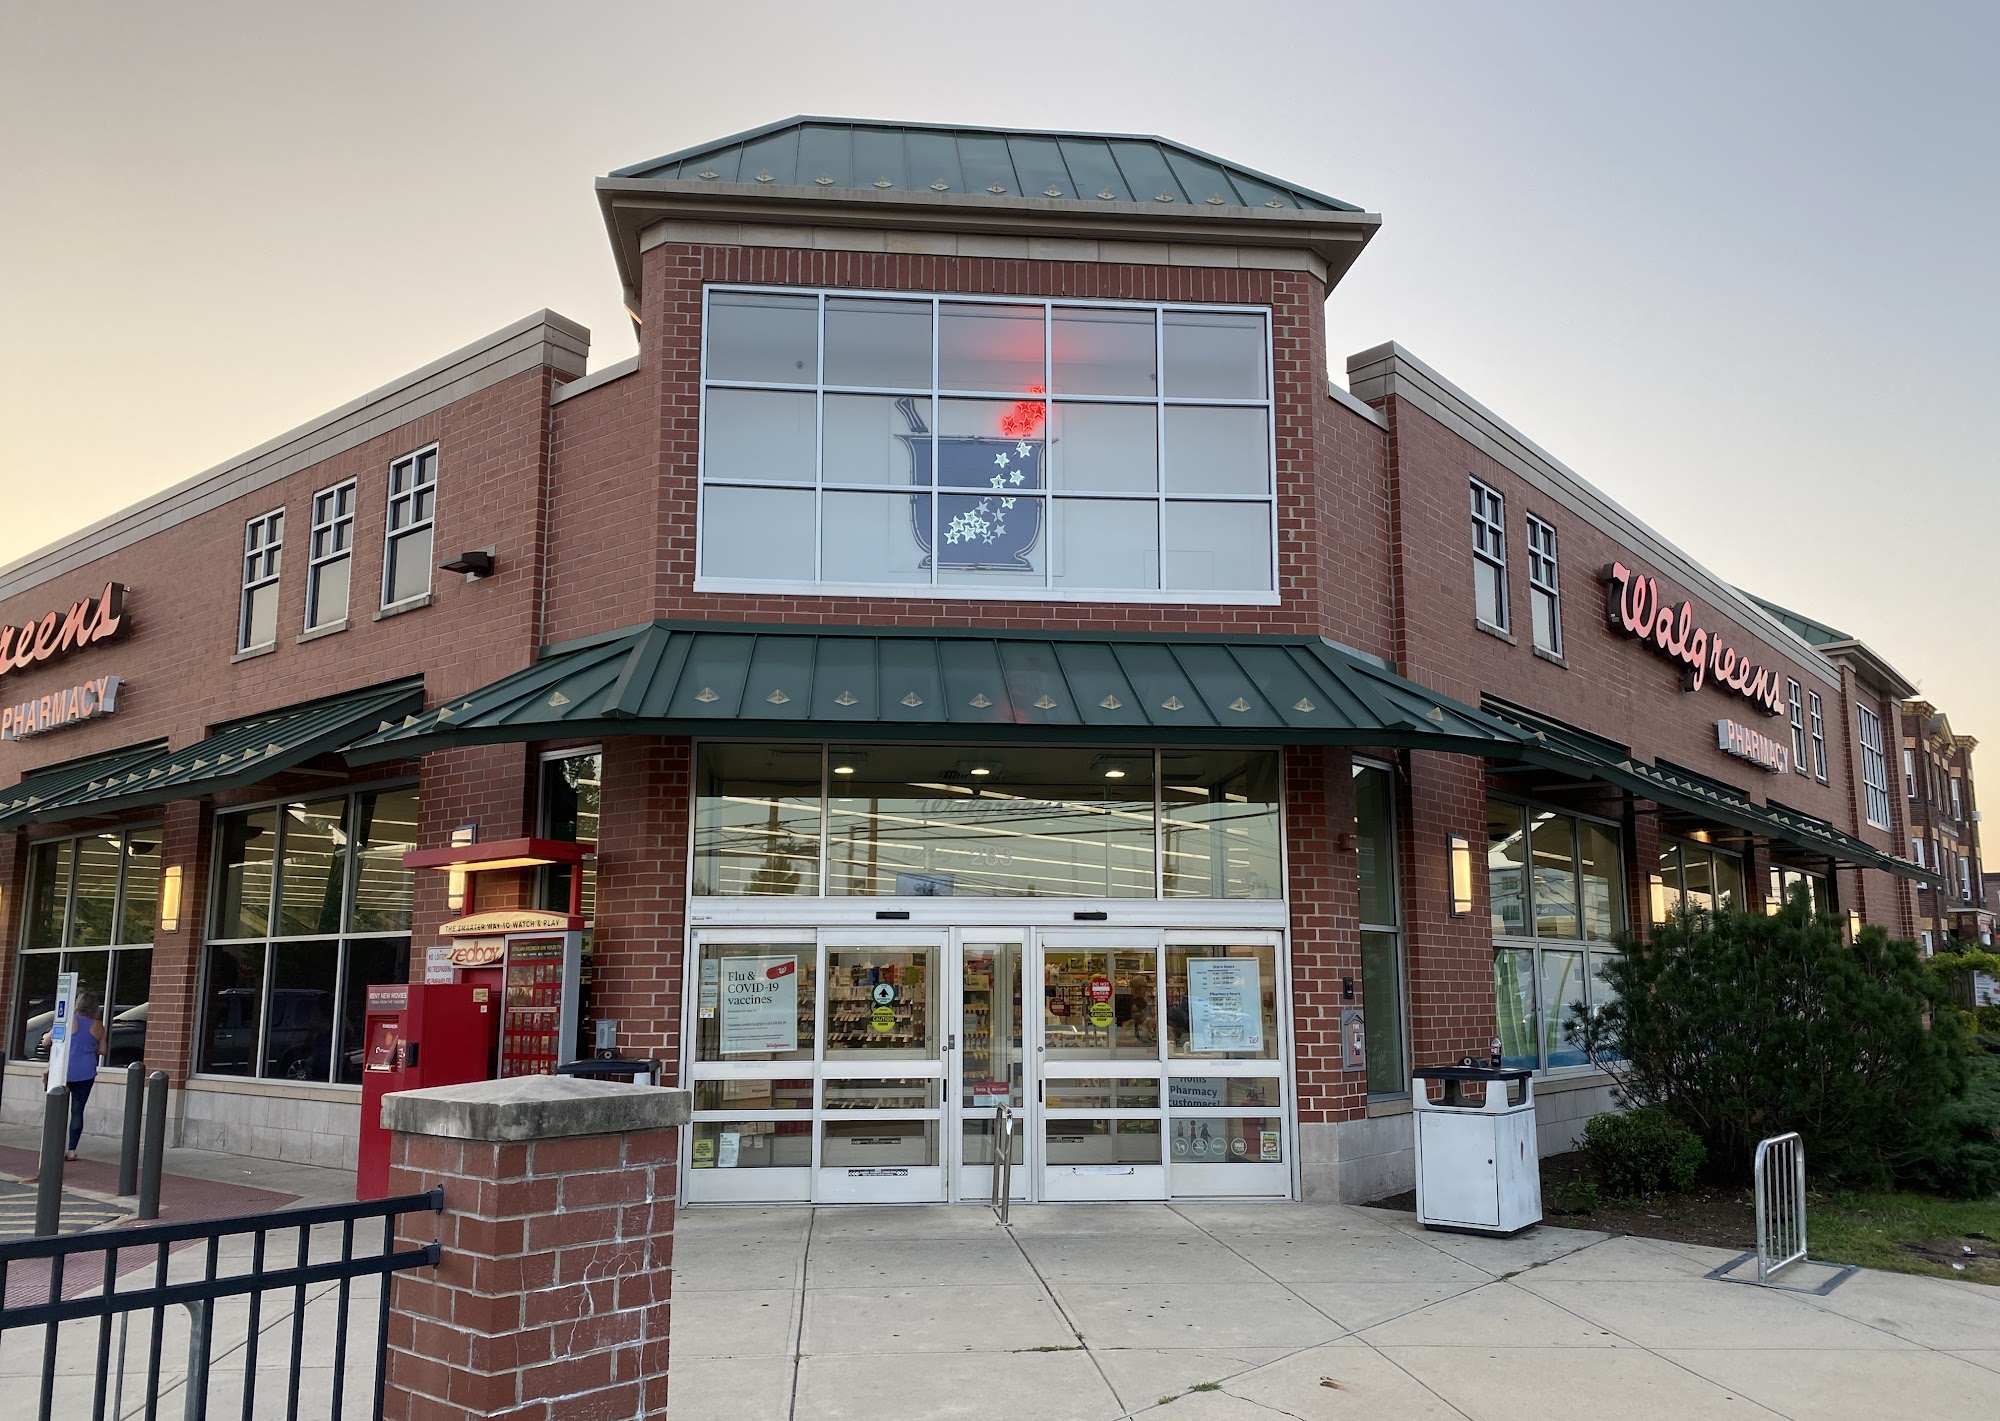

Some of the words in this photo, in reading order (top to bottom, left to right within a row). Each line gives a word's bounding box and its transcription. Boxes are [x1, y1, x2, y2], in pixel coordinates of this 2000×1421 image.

[1613, 561, 1785, 716] Walgreens
[1, 675, 111, 741] PHARMACY
[1727, 718, 1789, 775] PHARMACY
[969, 847, 1014, 867] 283
[513, 920, 535, 928] WATCH
[543, 919, 560, 927] PLAY
[447, 941, 501, 963] redbox
[728, 971, 745, 981] Flu
[747, 971, 756, 981] &
[727, 982, 780, 993] COVID-19
[728, 994, 772, 1005] vaccines
[1170, 1085, 1218, 1098] Pharmacy
